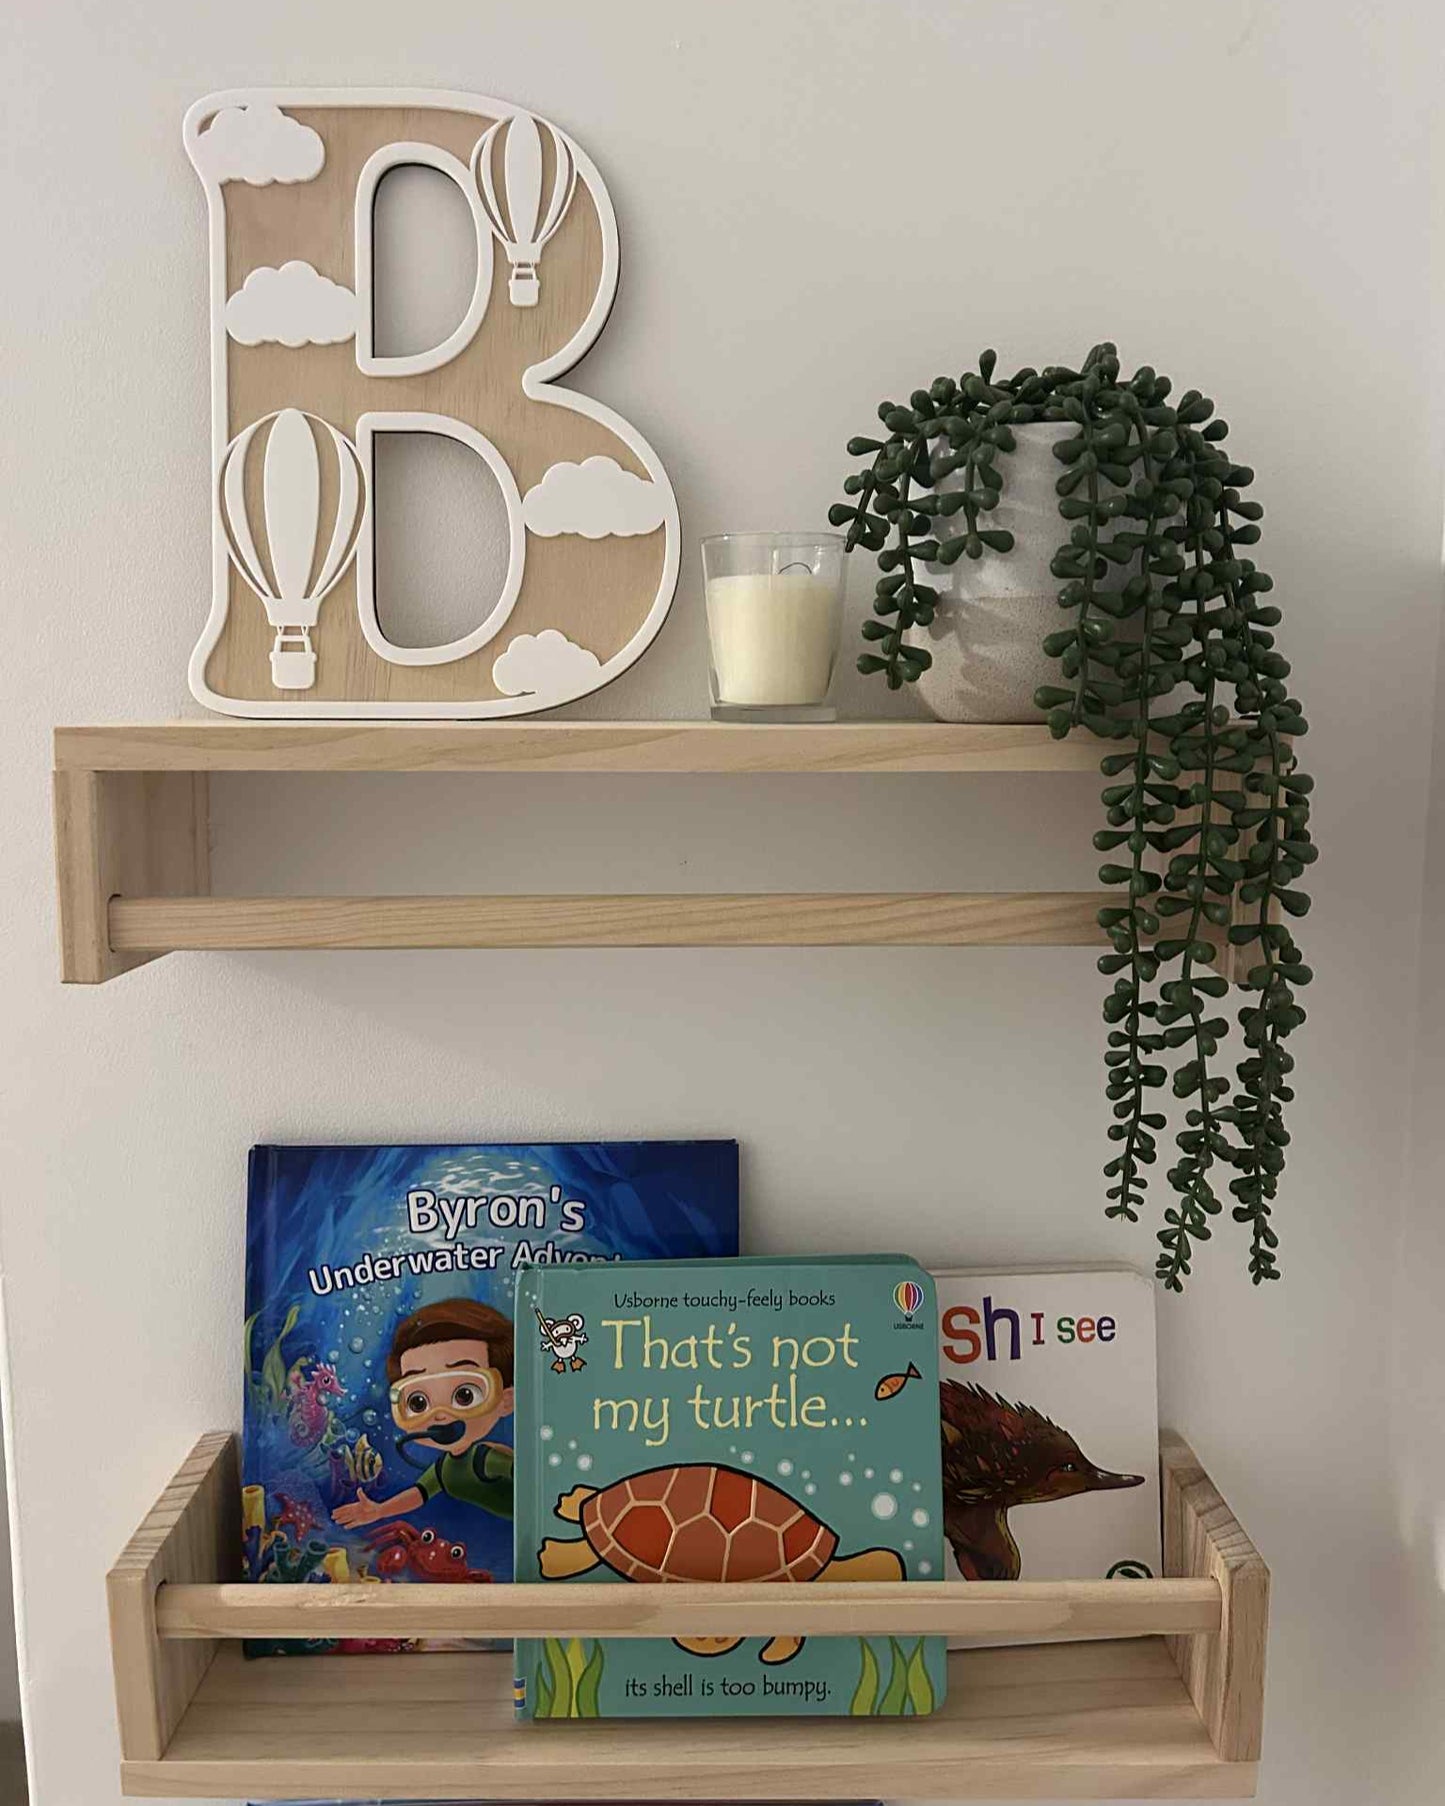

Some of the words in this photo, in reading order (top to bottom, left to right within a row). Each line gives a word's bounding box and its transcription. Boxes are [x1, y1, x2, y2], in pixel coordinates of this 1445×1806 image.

[182, 87, 682, 720] B
[407, 1186, 586, 1240] Byron's
[308, 1242, 503, 1296] Underwater
[614, 1291, 678, 1309] Usborne
[684, 1289, 783, 1311] touchy-feely
[789, 1289, 836, 1307] books
[601, 1315, 753, 1370] That's
[771, 1322, 860, 1371] not
[1030, 1312, 1046, 1346] I
[1056, 1316, 1117, 1344] see
[592, 1396, 670, 1447] my
[687, 1372, 868, 1430] turtle...
[625, 1677, 647, 1697] its
[653, 1674, 693, 1697] shell
[701, 1678, 715, 1697] is
[720, 1677, 756, 1697] too
[763, 1674, 832, 1702] bumpy.
